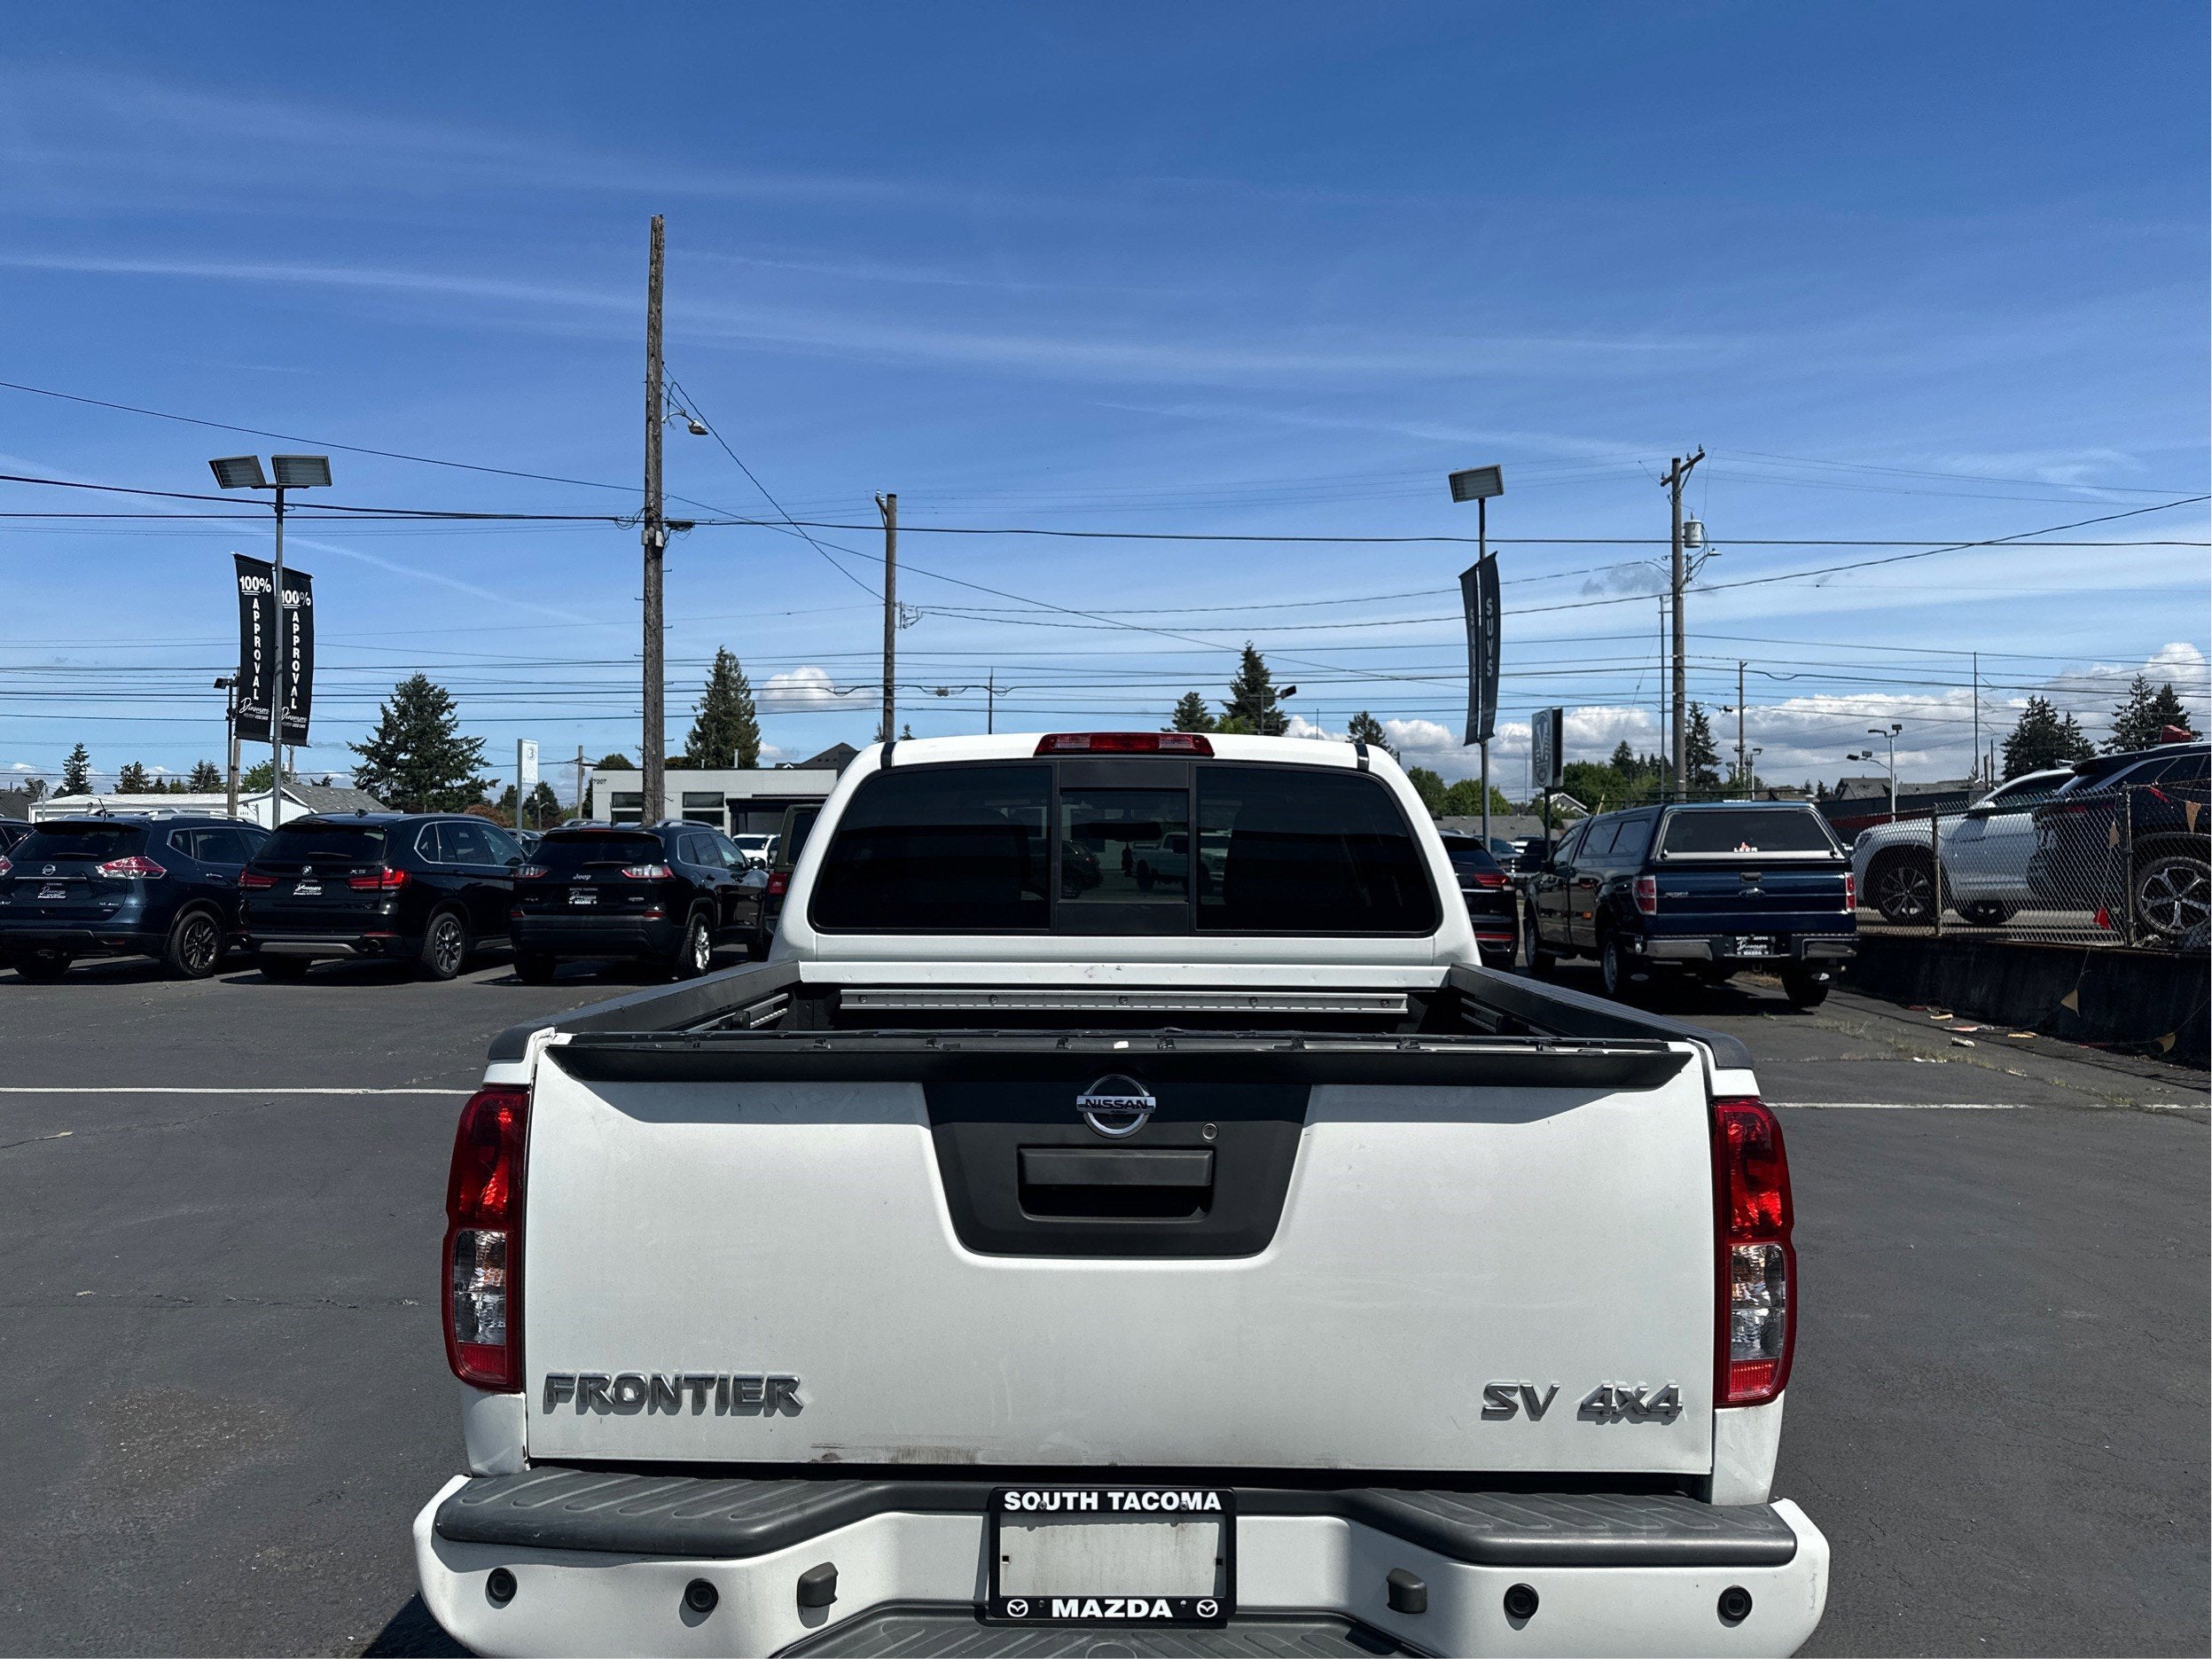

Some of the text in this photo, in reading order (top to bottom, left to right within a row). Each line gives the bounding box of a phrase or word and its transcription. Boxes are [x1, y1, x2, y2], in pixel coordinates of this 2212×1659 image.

[239, 575, 272, 593] 100%
[281, 590, 311, 606] 100%
[253, 598, 262, 700] APPROVAL
[291, 611, 301, 709] APPROVAL
[1085, 1099, 1148, 1109] NISSAN
[543, 1373, 804, 1412] FRONTIER
[1481, 1382, 1560, 1420] SV
[1004, 1491, 1222, 1511] SOUTH TACOMA
[1052, 1599, 1173, 1618] MAZDA
